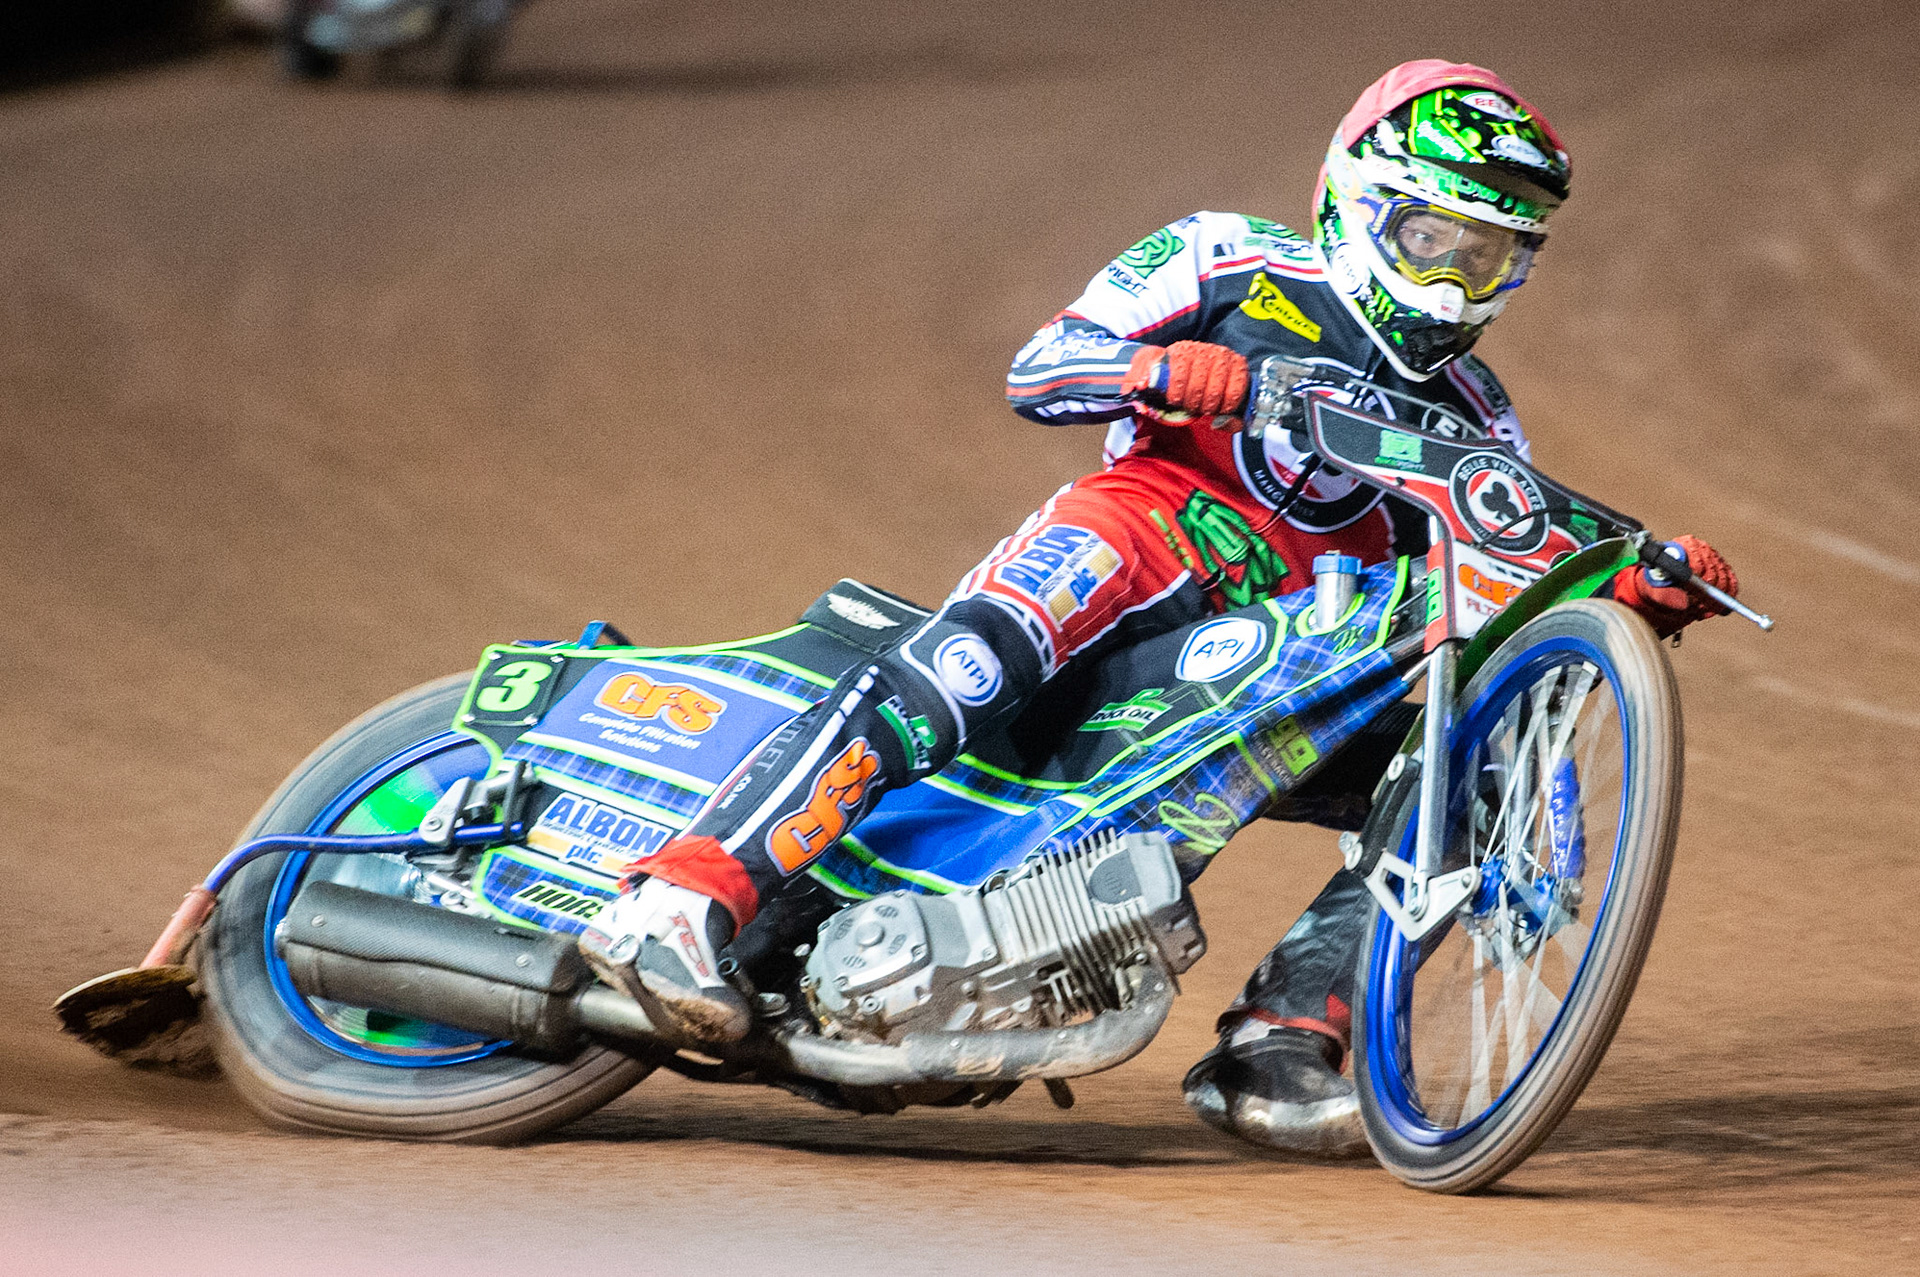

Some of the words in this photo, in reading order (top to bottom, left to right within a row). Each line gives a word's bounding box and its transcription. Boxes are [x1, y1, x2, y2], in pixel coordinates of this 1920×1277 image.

[1457, 457, 1489, 481] BELLE
[1490, 458, 1518, 478] VUE
[1457, 563, 1523, 606] CF
[476, 660, 552, 712] 3
[597, 672, 725, 734] CFS
[544, 796, 667, 854] ALBON
[768, 739, 880, 875] CFS
[565, 844, 603, 864] plc
